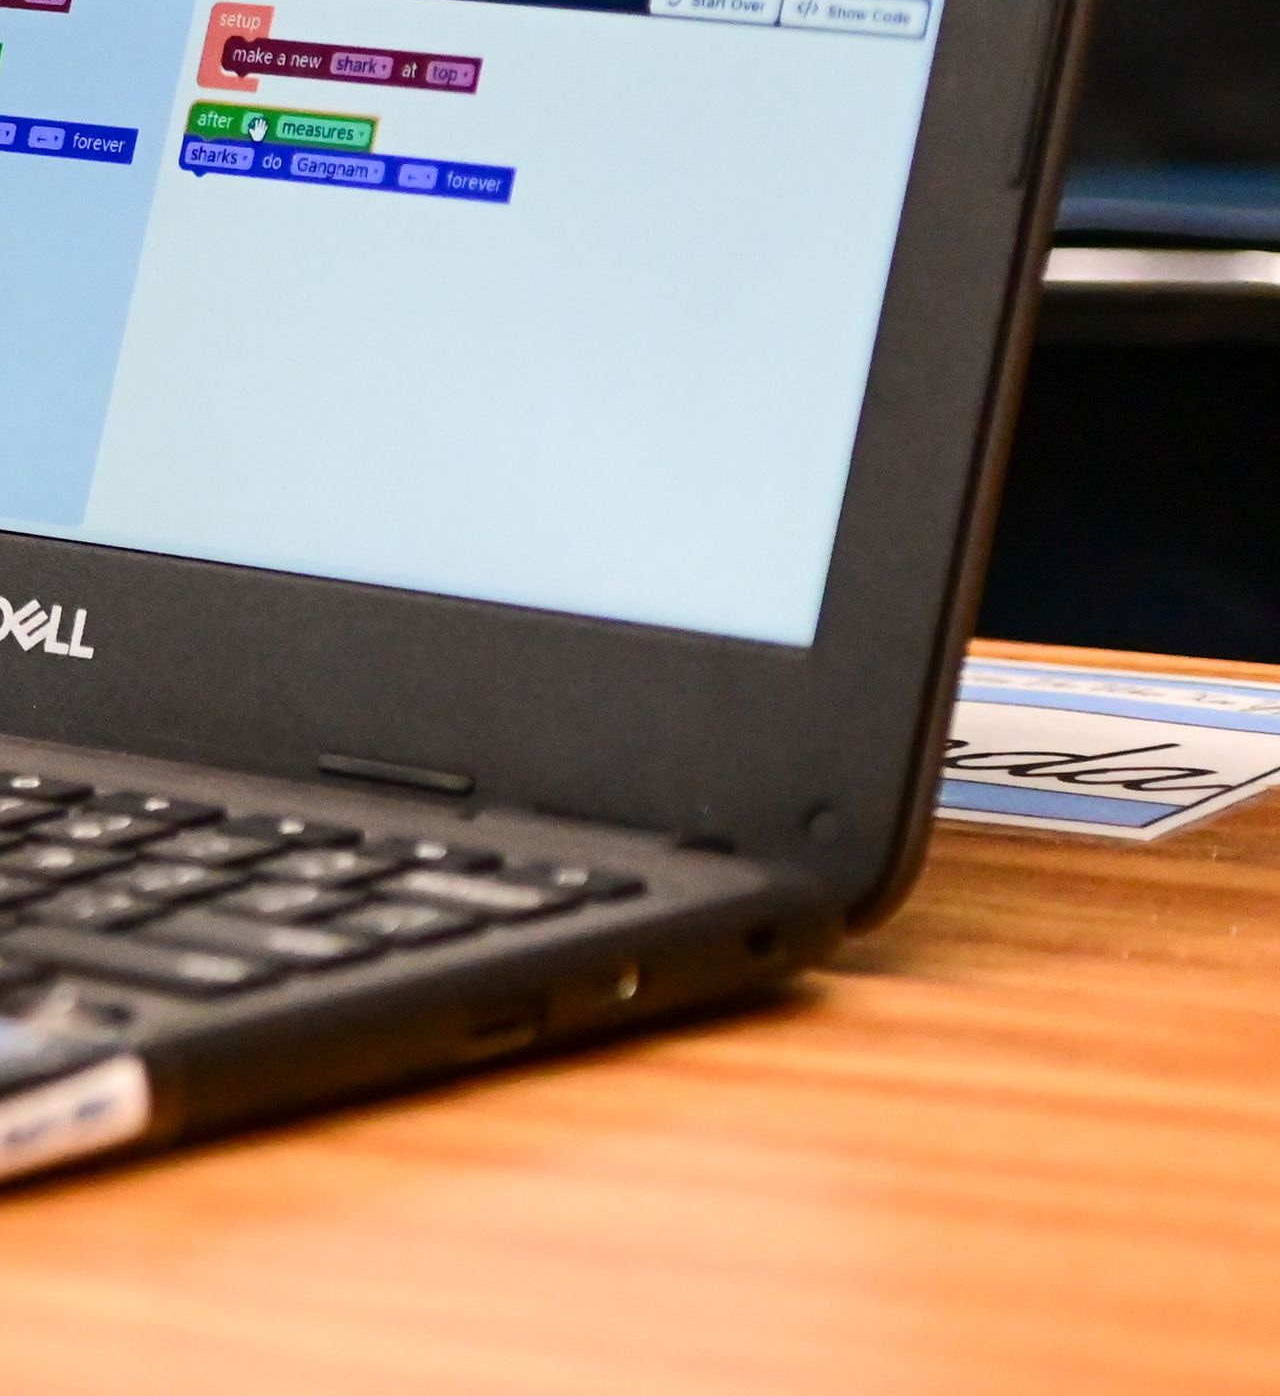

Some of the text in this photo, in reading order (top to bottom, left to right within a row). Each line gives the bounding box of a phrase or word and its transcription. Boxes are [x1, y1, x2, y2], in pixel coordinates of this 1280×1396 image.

[219, 10, 263, 32] setup
[231, 46, 459, 84] make a new shark at top
[72, 132, 127, 154] forever
[196, 111, 354, 142] after measures
[190, 144, 504, 194] sharks do Gangnam forever
[942, 738, 1230, 792] da
